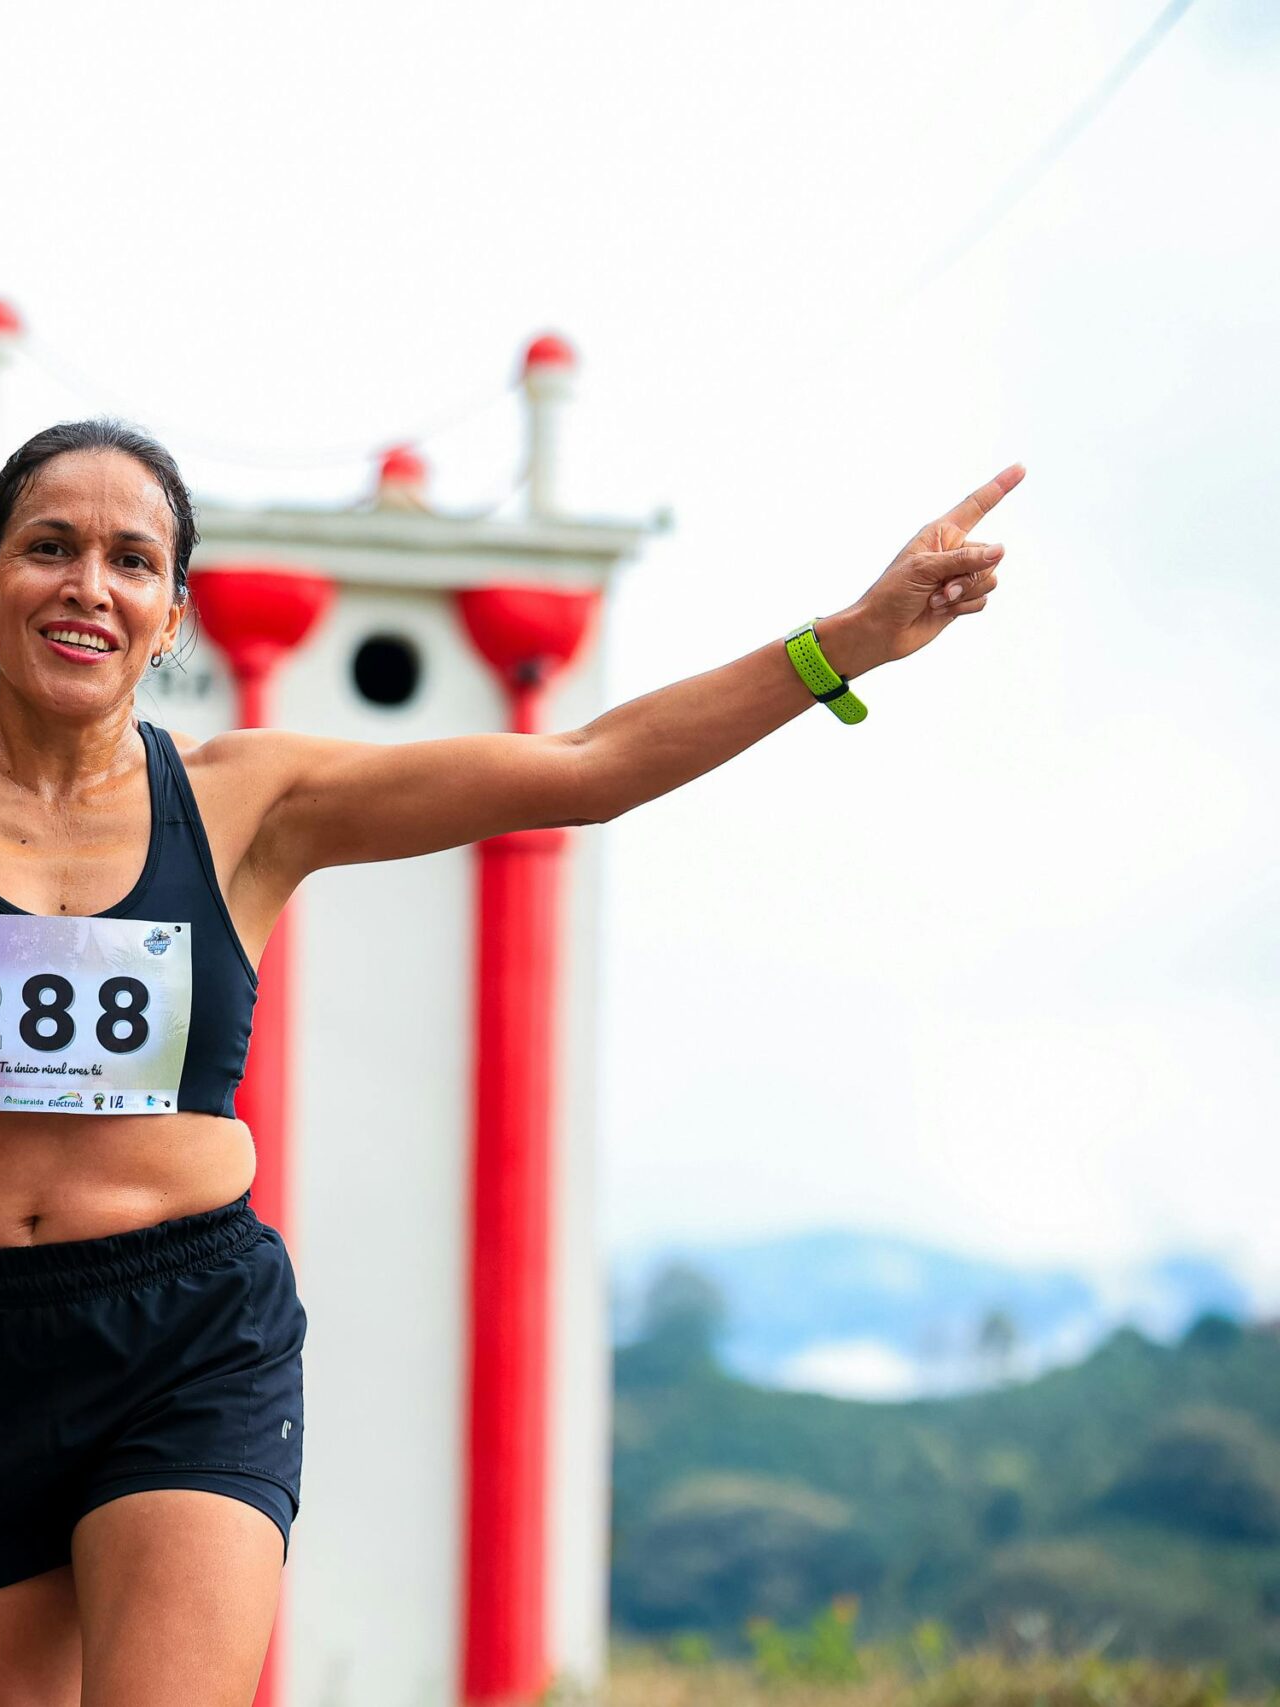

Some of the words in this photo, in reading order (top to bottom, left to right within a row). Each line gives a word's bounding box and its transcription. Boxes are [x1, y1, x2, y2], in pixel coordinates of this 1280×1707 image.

[14, 1062, 40, 1074] único
[42, 1061, 67, 1075] rival
[68, 1067, 90, 1076] eres
[91, 1064, 103, 1076] tú
[48, 1099, 84, 1108] Electrolit
